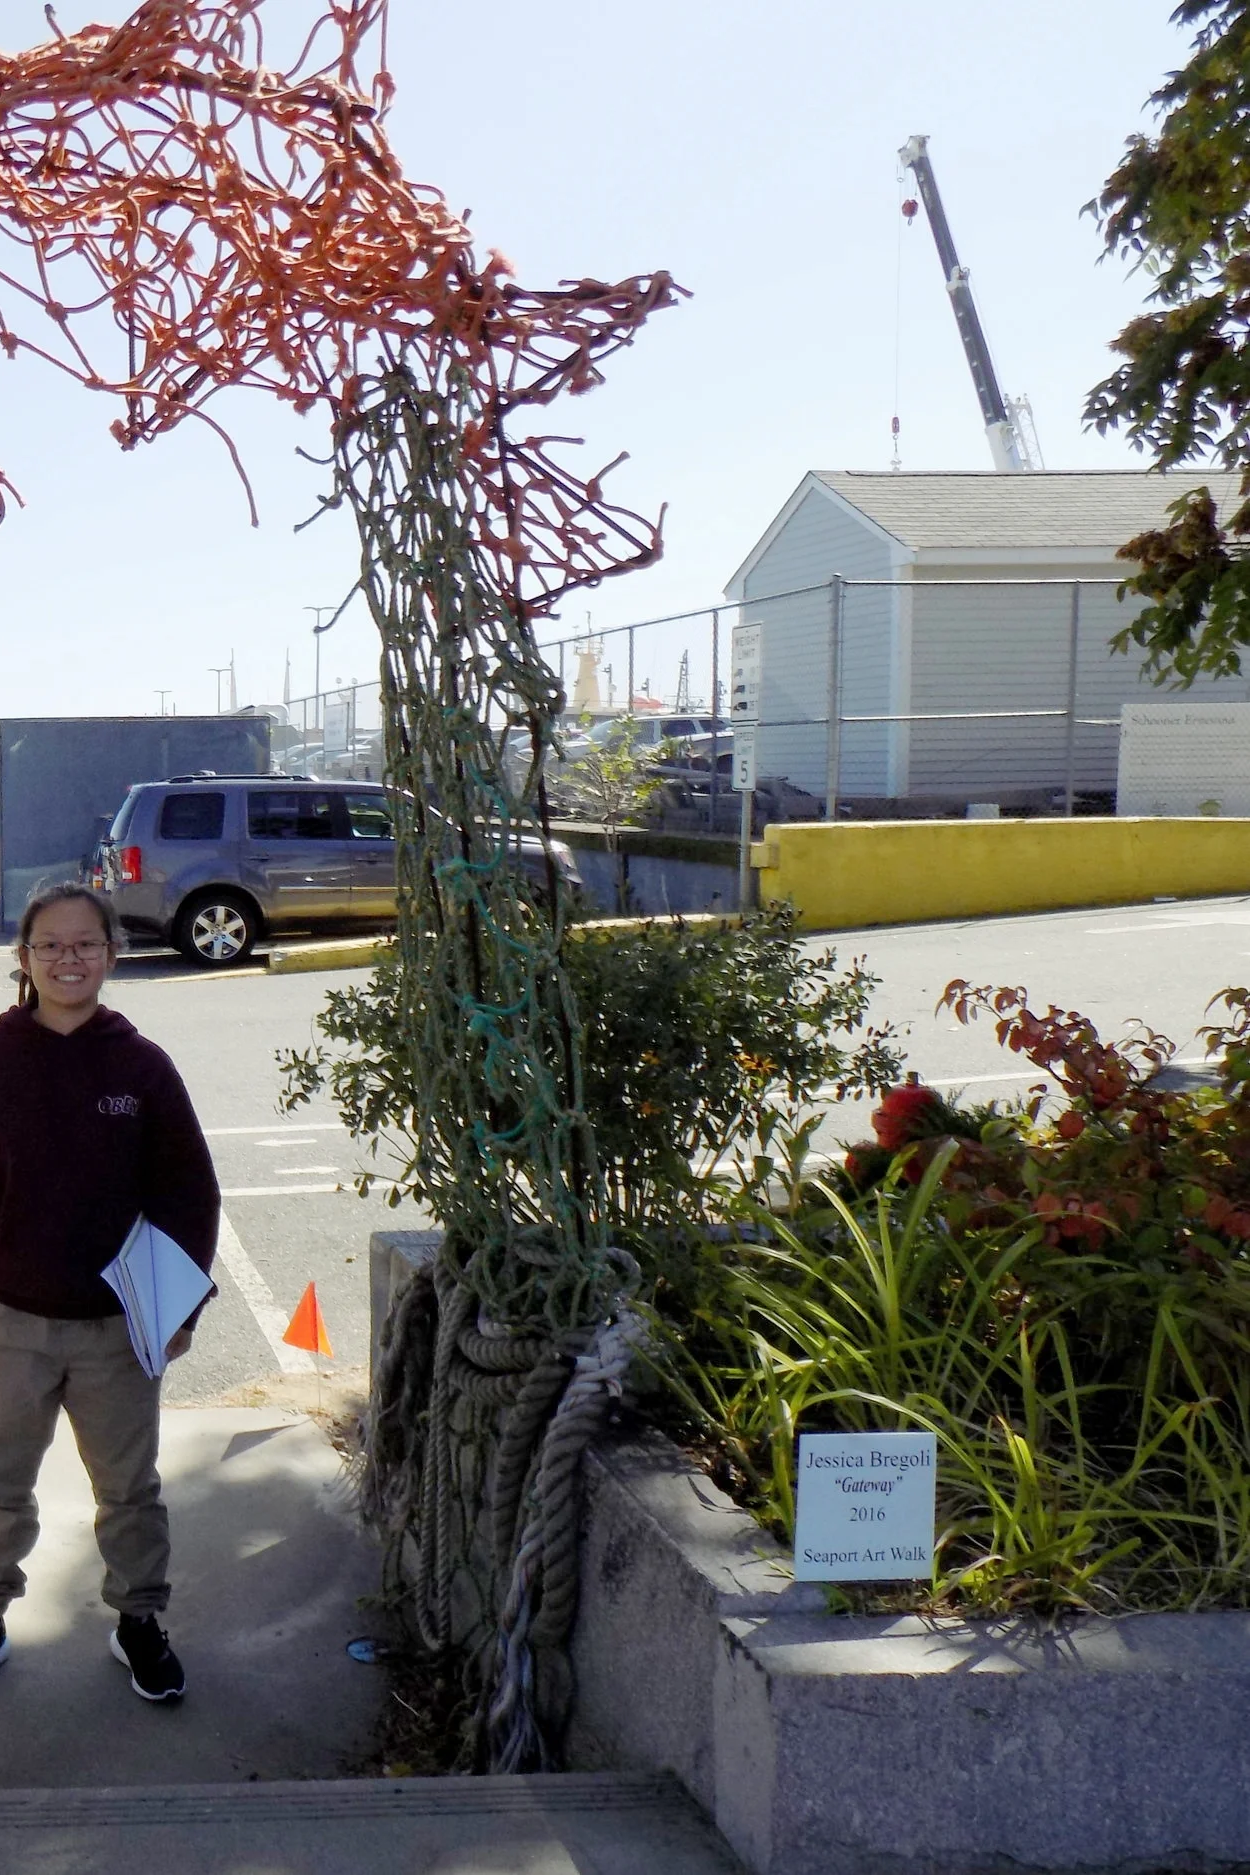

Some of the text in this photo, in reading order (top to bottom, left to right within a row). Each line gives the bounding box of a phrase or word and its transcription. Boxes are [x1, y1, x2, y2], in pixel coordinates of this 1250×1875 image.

[740, 760, 749, 784] 5
[806, 1449, 931, 1471] Jessica Bregoli
[849, 1507, 886, 1522] 2016
[803, 1546, 927, 1566] Seaport Art Walk
